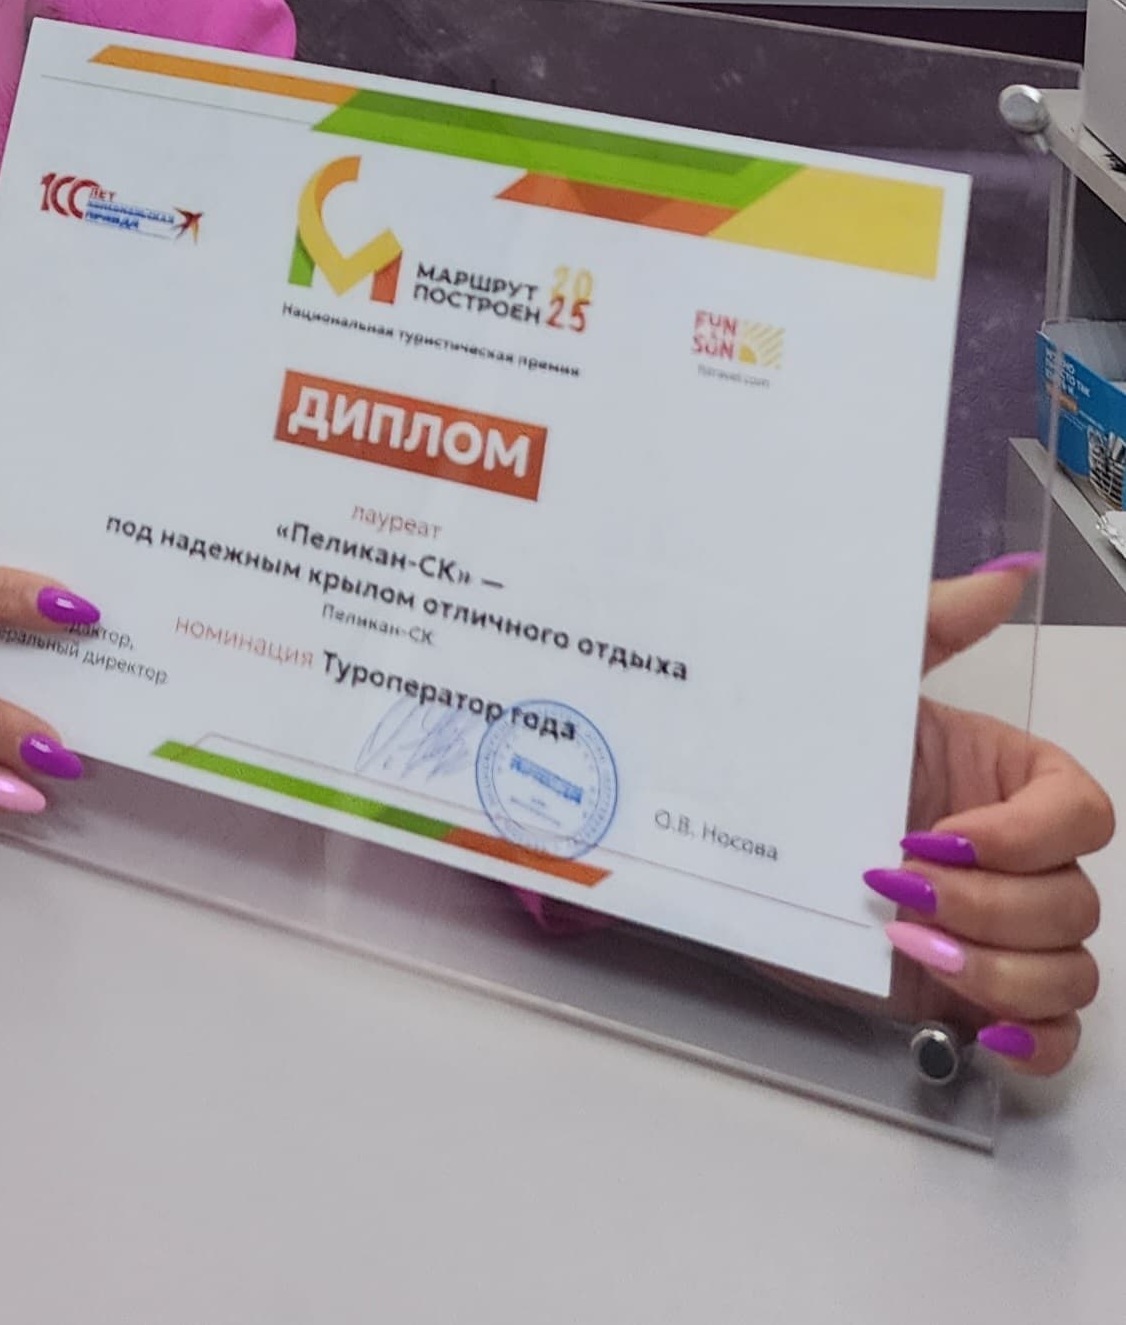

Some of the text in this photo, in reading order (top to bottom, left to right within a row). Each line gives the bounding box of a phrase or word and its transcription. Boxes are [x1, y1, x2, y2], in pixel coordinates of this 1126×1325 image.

[416, 262, 538, 301] МАРШРУТ
[413, 284, 591, 333] ПОСТРОЕН 25
[282, 303, 580, 377] Национальная туристическая премия
[287, 386, 530, 479] ДИПЛОМ
[351, 505, 442, 538] лауреат
[276, 521, 472, 584] «Пеликан-СК»
[106, 515, 687, 681] под надежным крылом отличного отдыха
[322, 603, 434, 646] Пеликан-СК
[82, 649, 168, 685] директор
[175, 617, 576, 742] номинация Туроператор года
[702, 821, 778, 861] Носова
